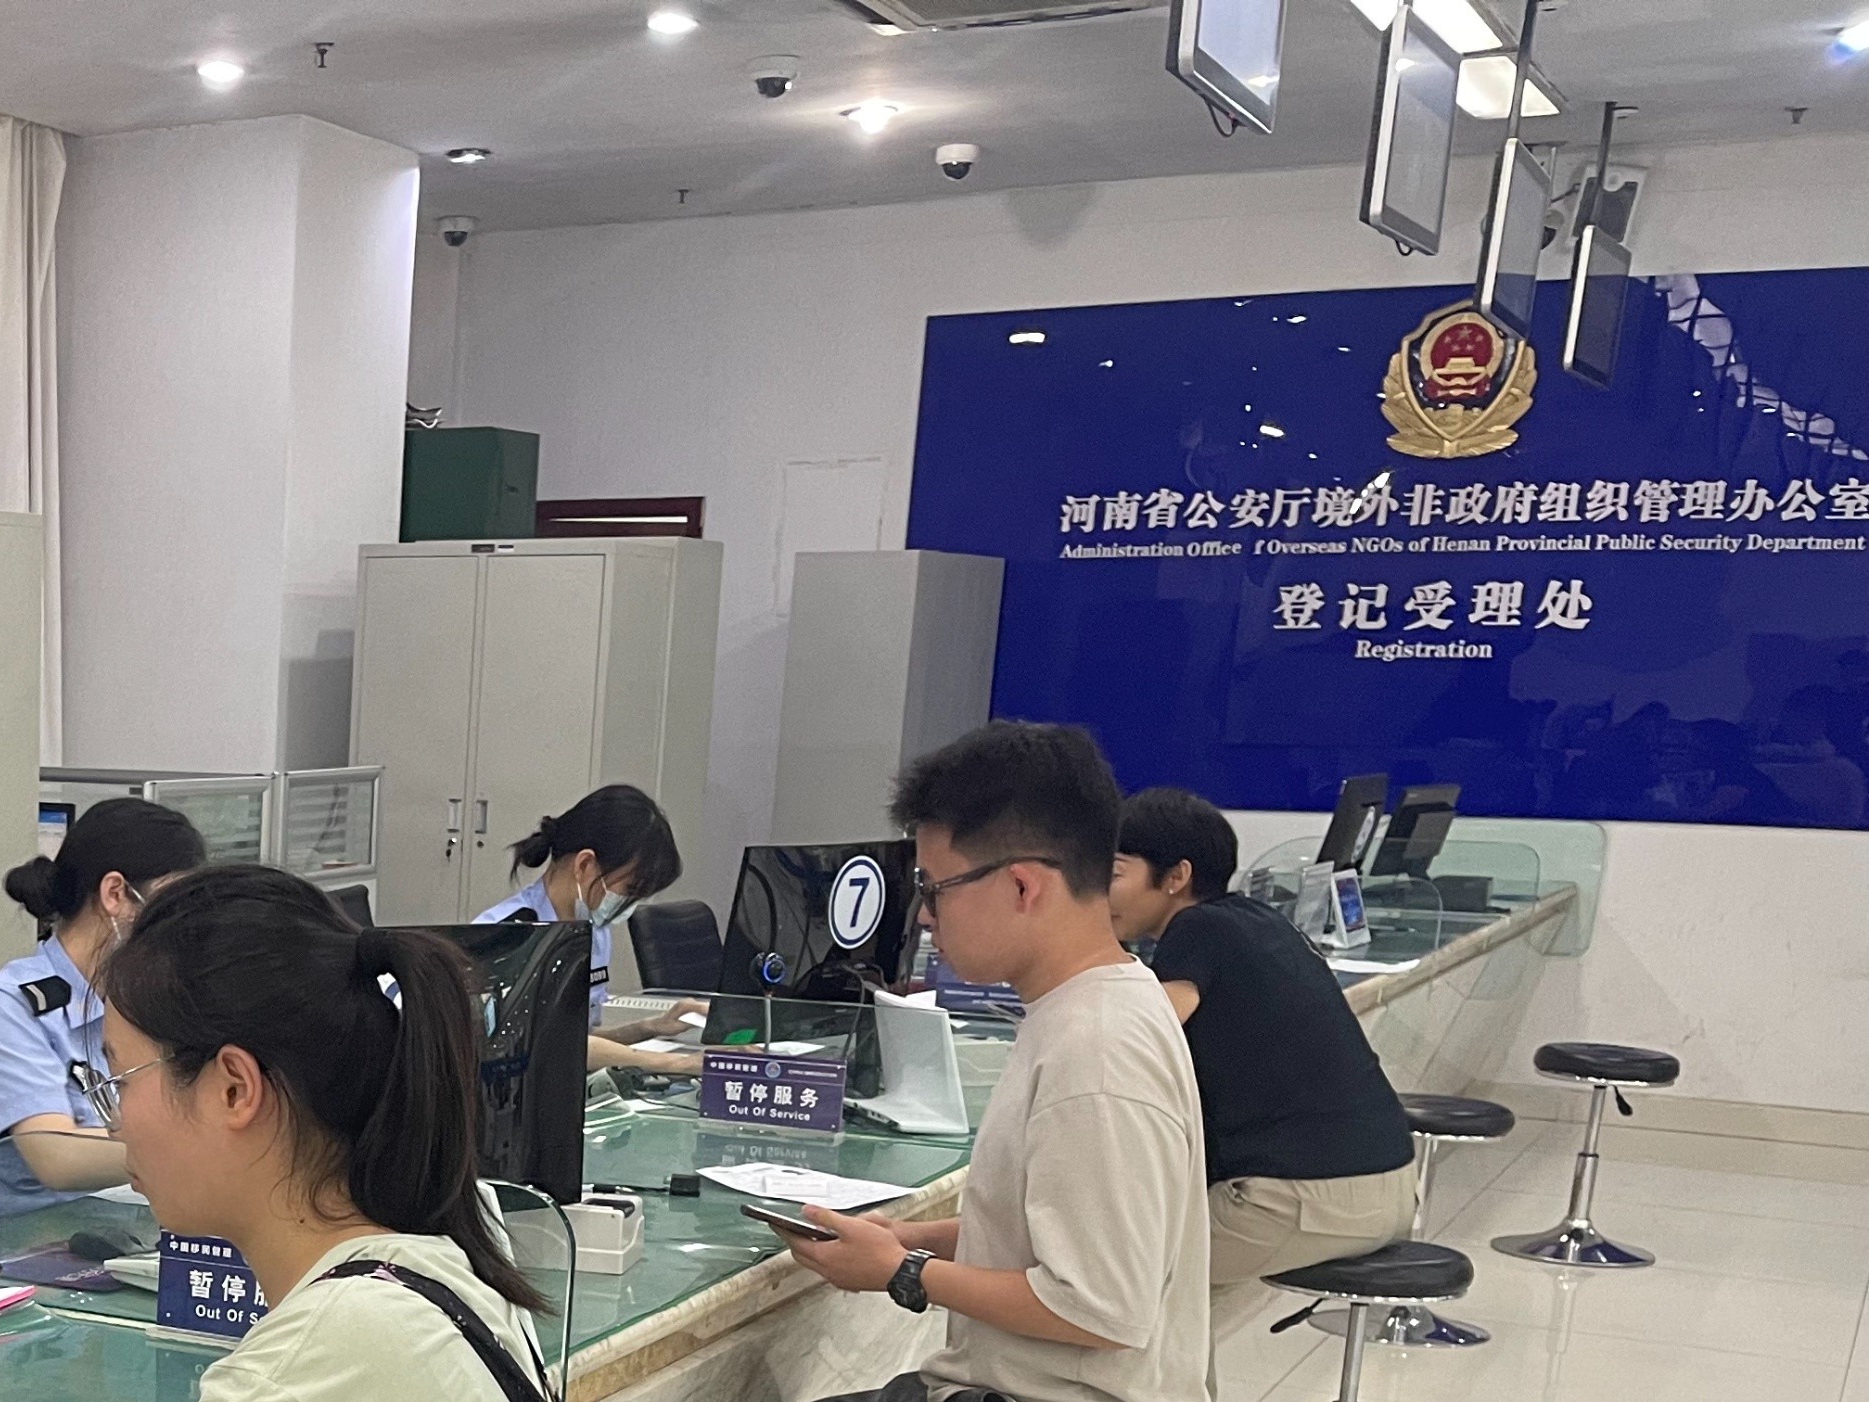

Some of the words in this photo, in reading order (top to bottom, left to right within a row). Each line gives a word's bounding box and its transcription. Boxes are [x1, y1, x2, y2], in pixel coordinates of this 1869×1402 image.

[1060, 543, 1184, 559] Administration
[1187, 541, 1242, 558] Office
[1267, 538, 1347, 555] Overseas
[1350, 536, 1404, 554] NGOs
[1408, 536, 1430, 552] of
[1432, 535, 1491, 552] Henan
[1494, 534, 1591, 552] Provincial
[1594, 533, 1656, 551] Public
[1658, 533, 1743, 554] Security
[1745, 532, 1867, 554] Department
[1273, 579, 1593, 632] 登记受理处
[1355, 639, 1493, 661] Registration
[849, 877, 870, 928] 7
[724, 1080, 819, 1109] 暂停服务
[728, 1104, 749, 1116] Out
[752, 1106, 767, 1117] Of
[769, 1108, 811, 1122] Service
[195, 1304, 221, 1320] Out
[226, 1307, 244, 1324] Of
